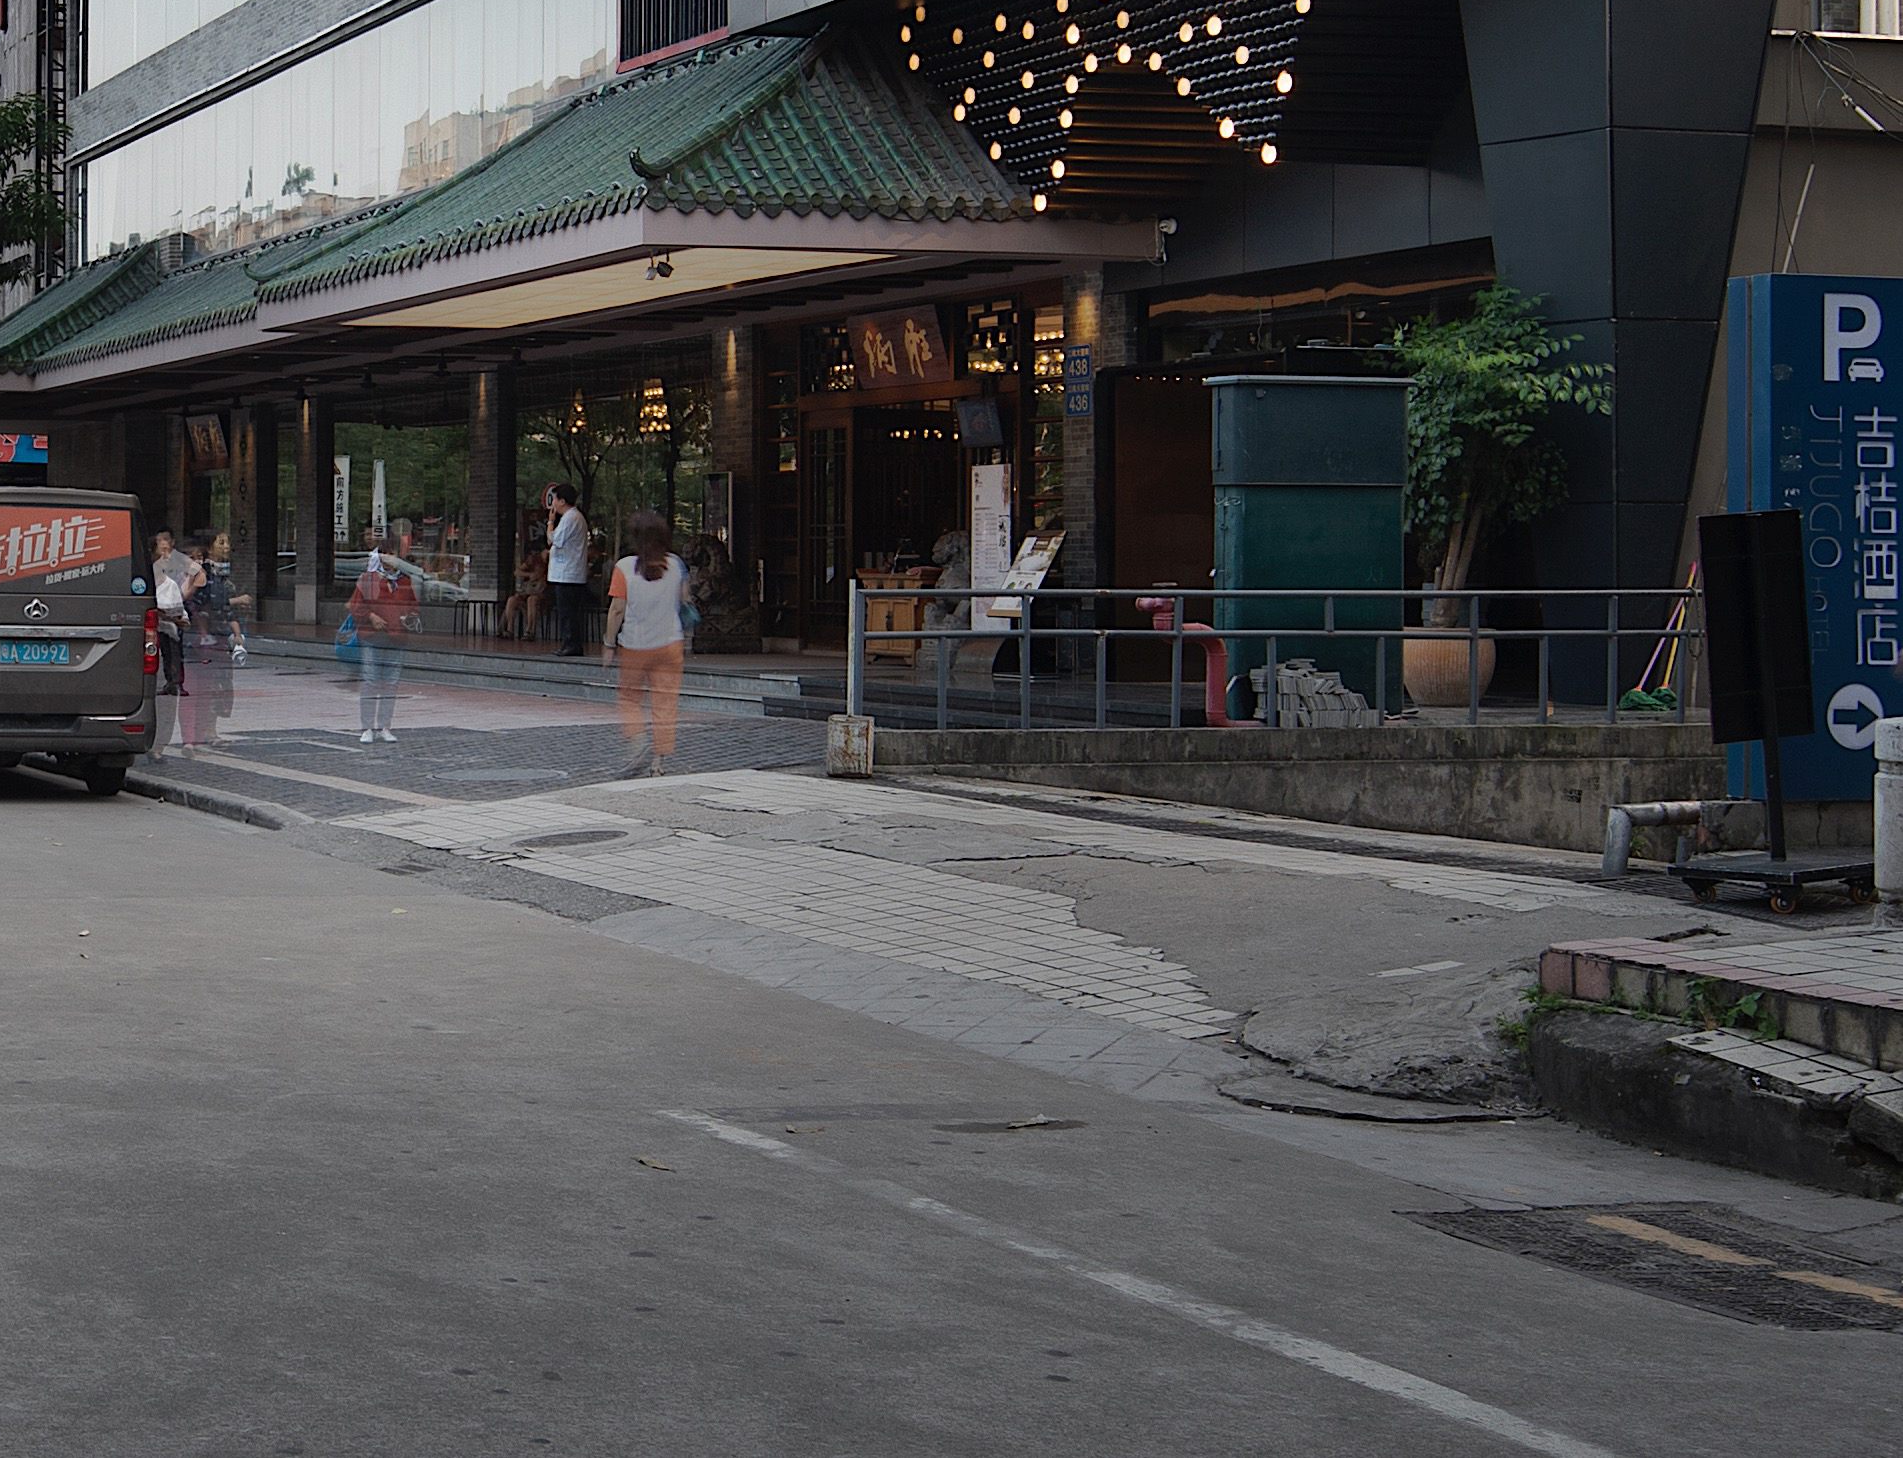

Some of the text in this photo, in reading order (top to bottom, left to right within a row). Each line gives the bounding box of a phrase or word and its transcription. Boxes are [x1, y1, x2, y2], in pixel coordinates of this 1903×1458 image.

[1069, 359, 1088, 376] 438
[1823, 293, 1883, 381] P
[1069, 394, 1088, 411] 436
[1853, 406, 1898, 666] 吉桔酒店
[1810, 576, 1829, 665] HOTEL
